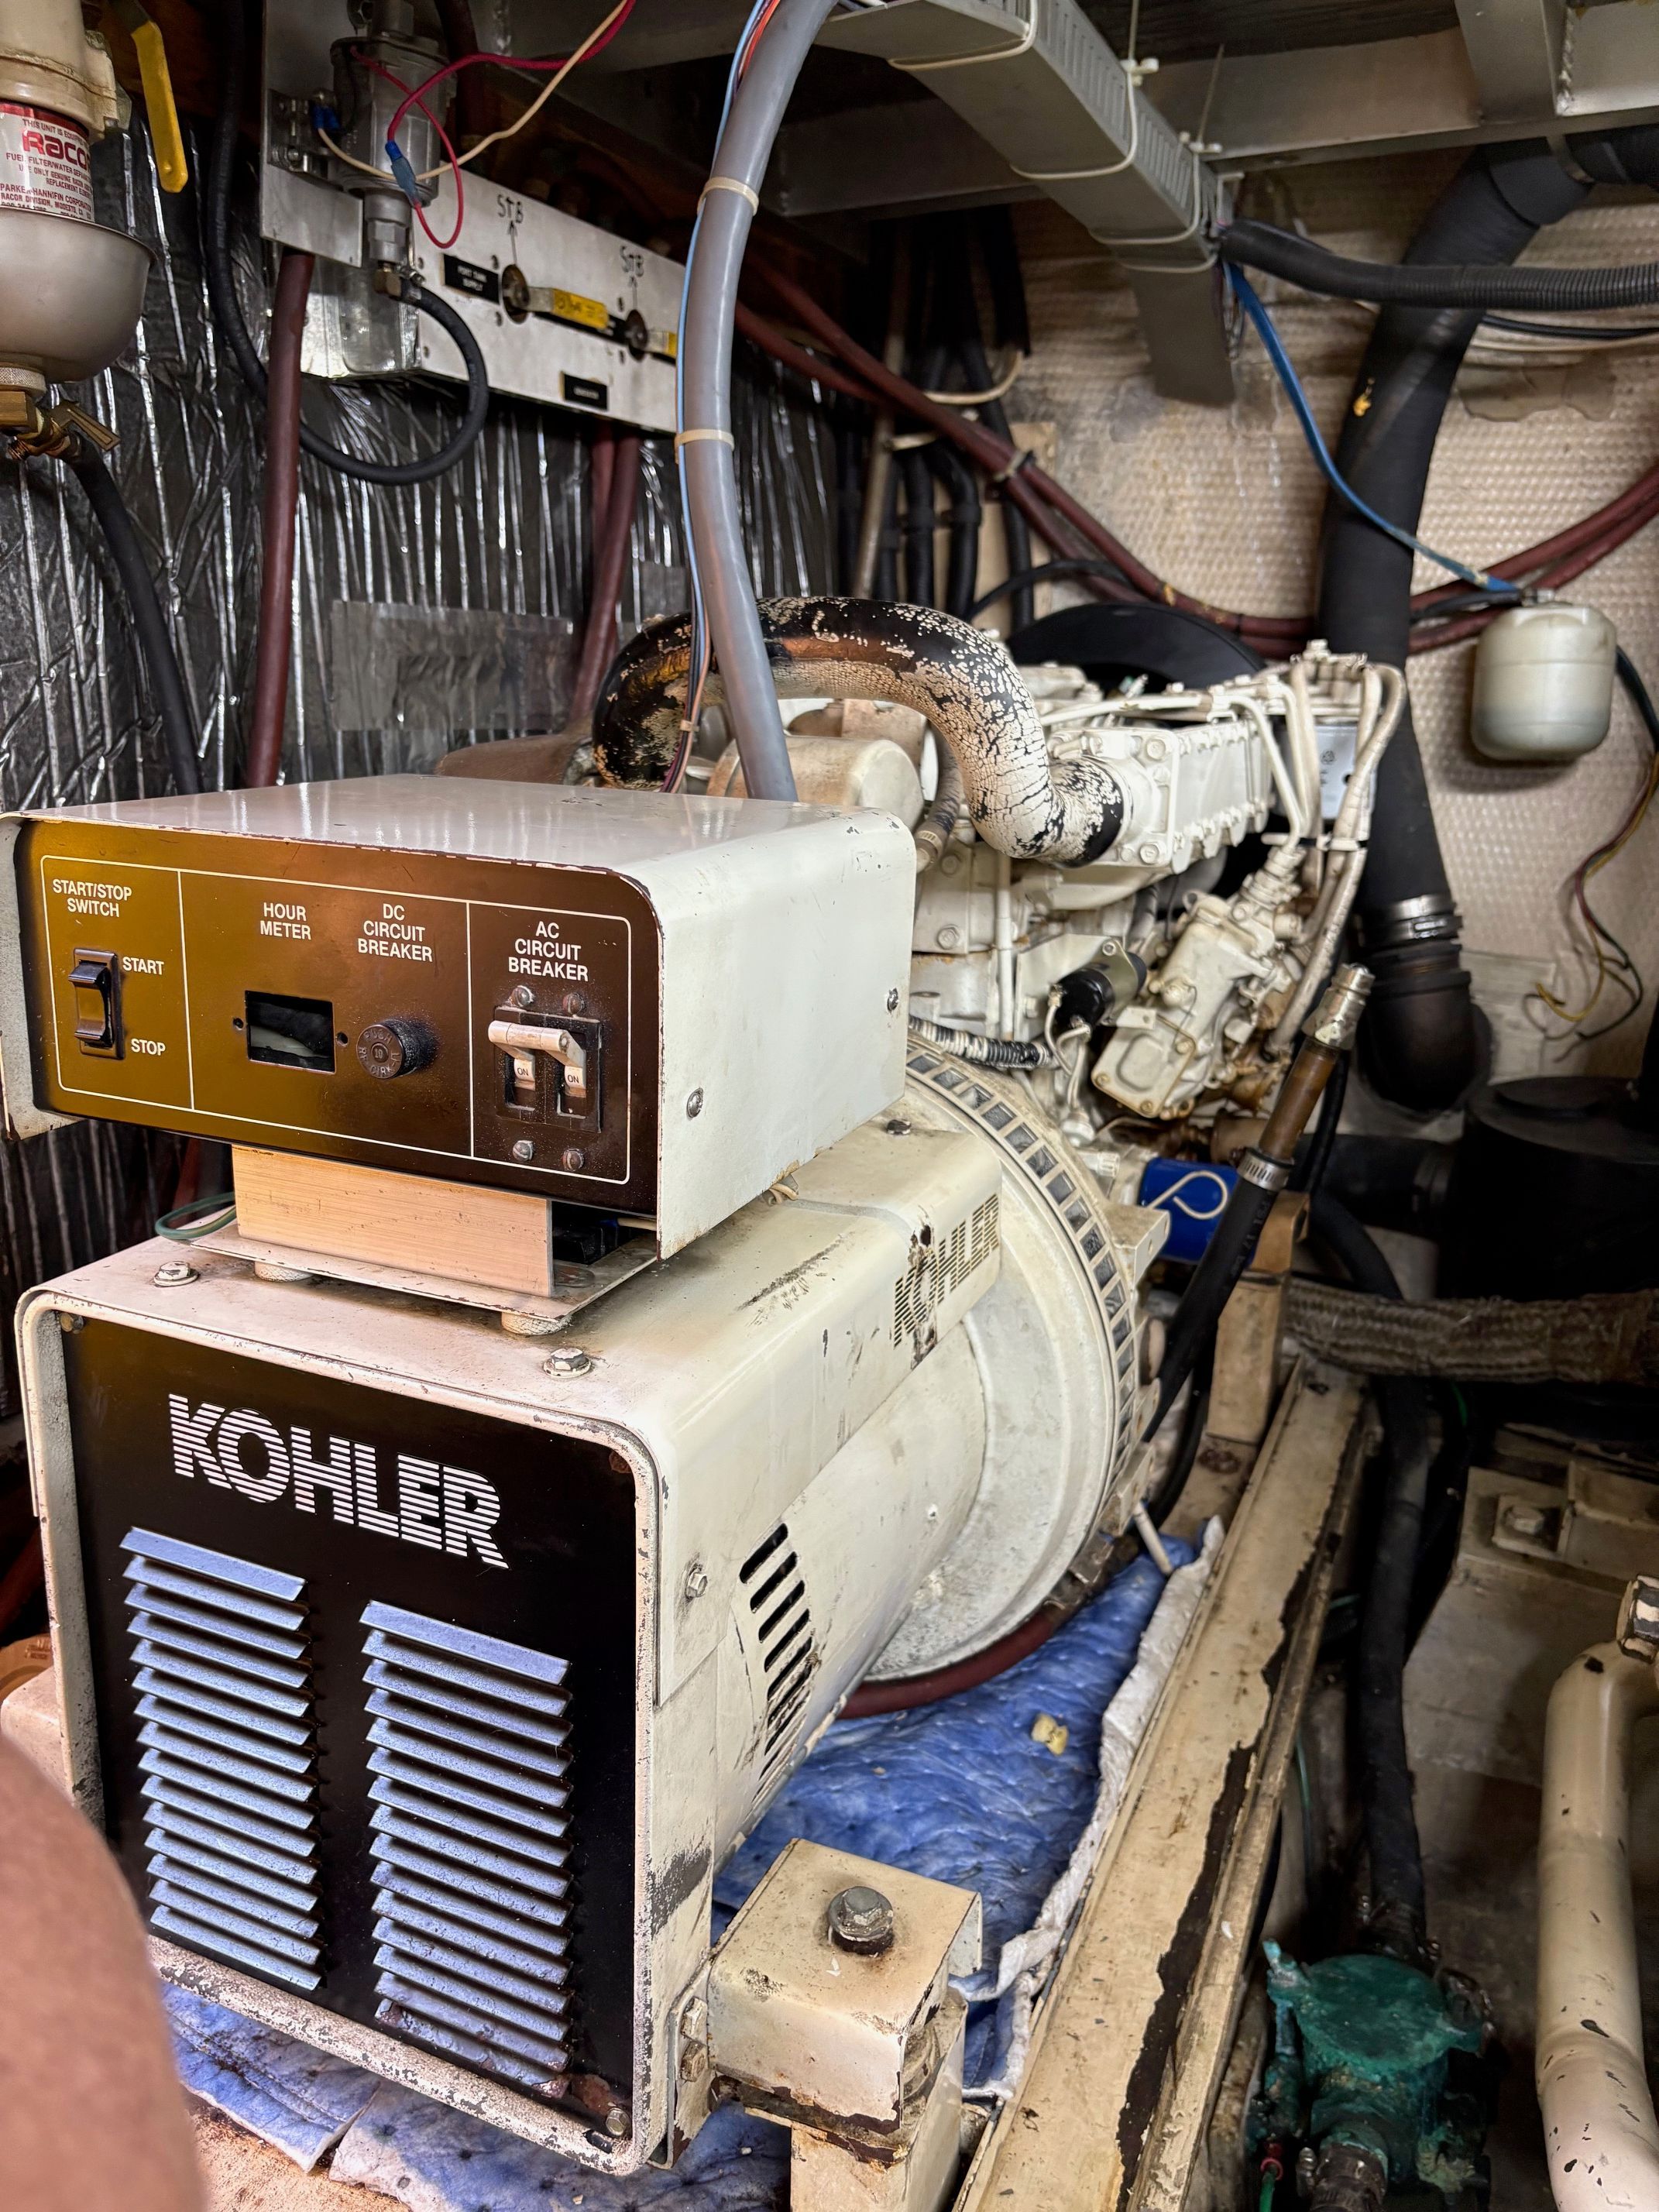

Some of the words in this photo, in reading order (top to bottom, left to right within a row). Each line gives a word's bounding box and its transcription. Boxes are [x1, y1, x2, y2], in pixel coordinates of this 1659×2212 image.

[22, 118, 41, 130] THIS
[41, 122, 57, 135] UNIT
[57, 129, 64, 137] IS
[19, 164, 33, 173] UE
[34, 167, 49, 177] ONLY
[1, 193, 23, 202] RACOR
[497, 194, 524, 225] STB
[620, 246, 644, 277] STB
[53, 879, 132, 901] START/STOP
[67, 898, 120, 918] SWITCH
[263, 902, 307, 922] HOUR
[383, 903, 405, 921] DC
[259, 920, 311, 940] METER
[363, 920, 426, 942] CIRCUIT
[535, 921, 559, 939] AC
[357, 938, 433, 963] BREAKER
[514, 938, 582, 961] CIRCUIT
[122, 956, 165, 975] START
[508, 957, 589, 982] BREAKER
[131, 1038, 166, 1056] STOP
[517, 1067, 529, 1077] ON
[567, 1074, 579, 1084] ON
[894, 1194, 999, 1350] KOHLER
[169, 1393, 510, 1569] KOHLER
